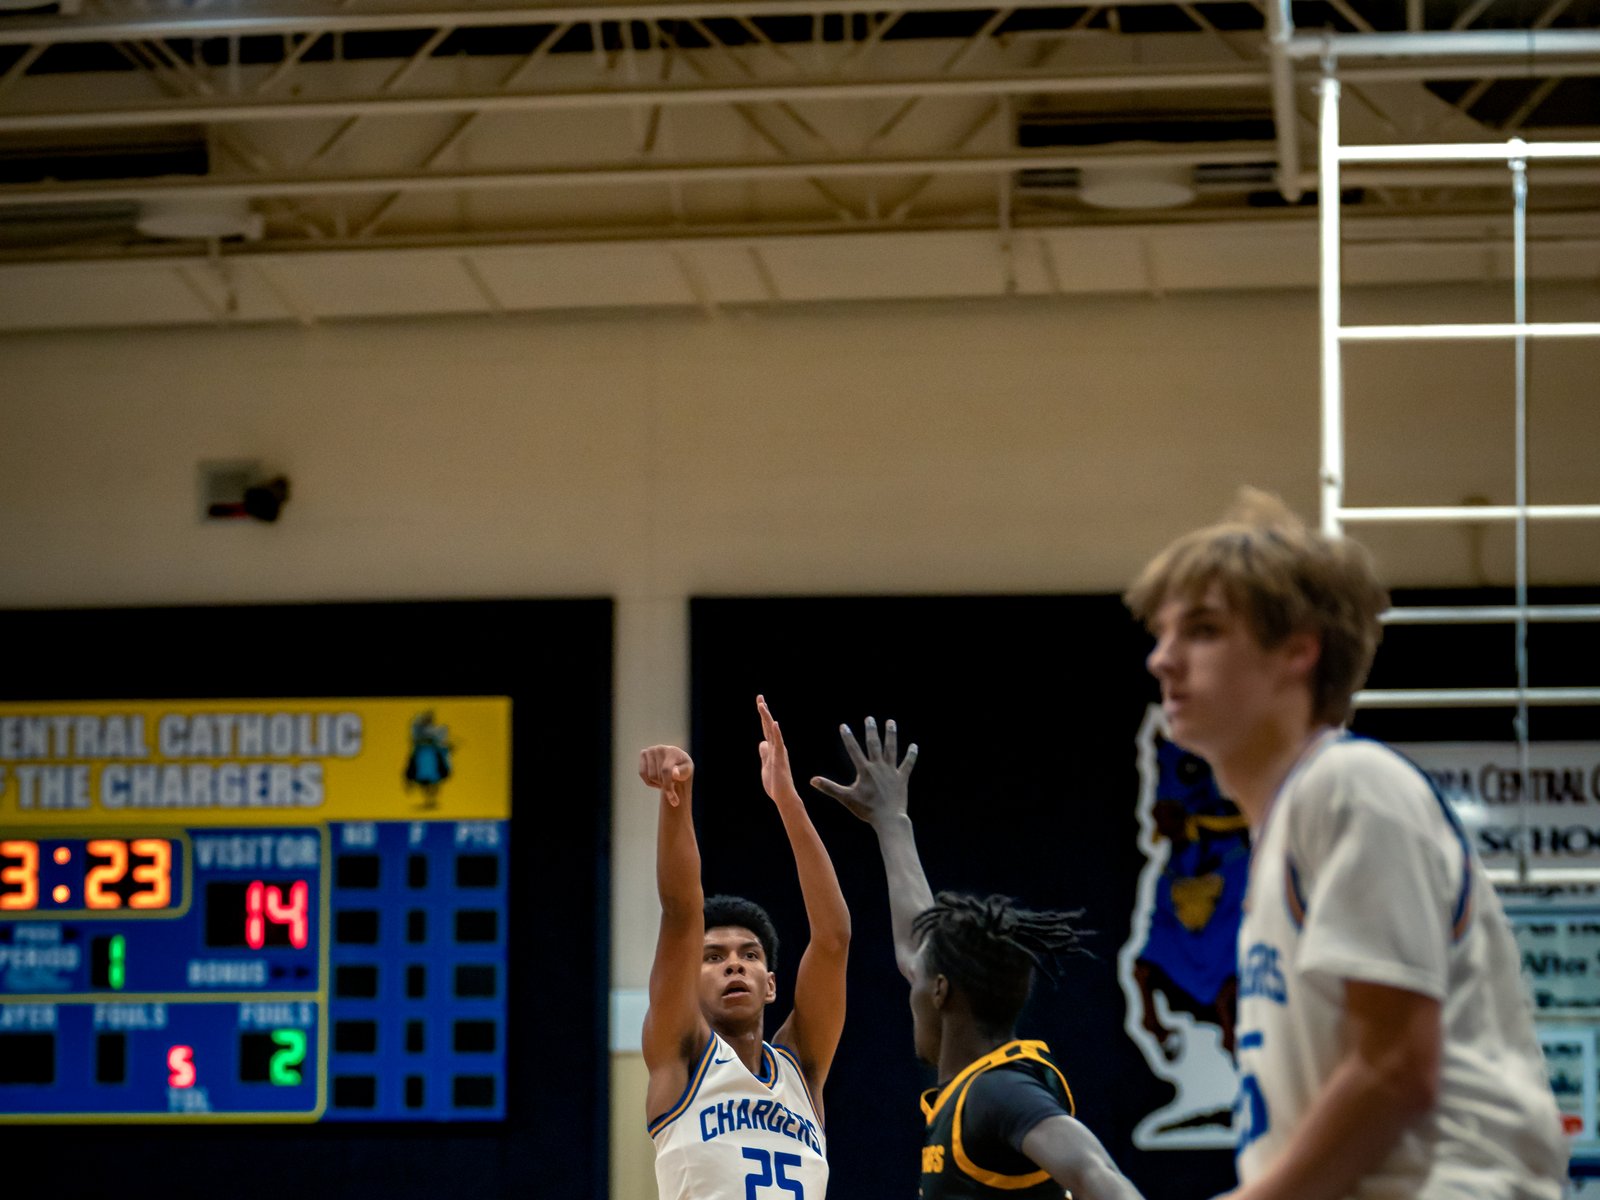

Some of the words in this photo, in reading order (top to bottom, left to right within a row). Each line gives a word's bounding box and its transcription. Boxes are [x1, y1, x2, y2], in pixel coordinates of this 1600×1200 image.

[158, 712, 365, 758] CATHOLIC
[14, 764, 92, 810] THE
[101, 763, 326, 809] CHARGERS
[0, 838, 172, 911] 3:23
[195, 835, 318, 868] VISITOR
[245, 880, 309, 950] 14
[108, 934, 126, 990] 1
[188, 960, 267, 985] BONUS
[93, 1003, 166, 1029] FOULS
[240, 1003, 312, 1029] FOULS
[269, 1028, 307, 1087] 2
[699, 1098, 825, 1158] CHARGERS
